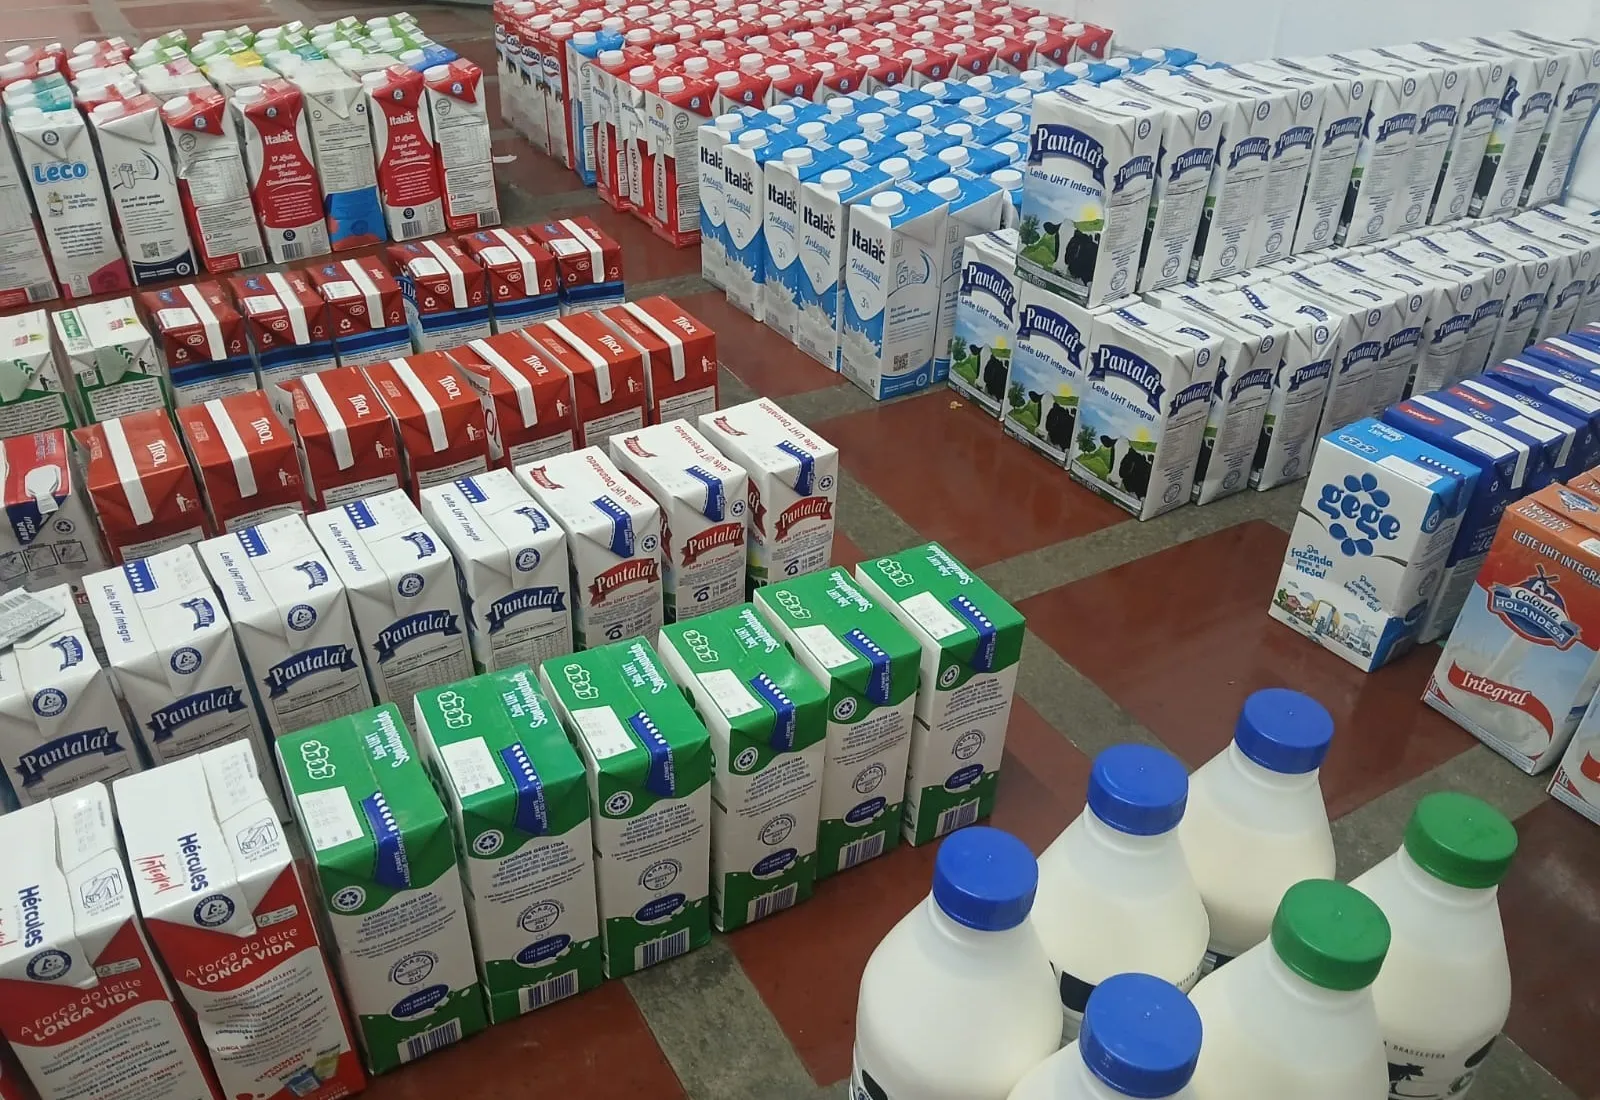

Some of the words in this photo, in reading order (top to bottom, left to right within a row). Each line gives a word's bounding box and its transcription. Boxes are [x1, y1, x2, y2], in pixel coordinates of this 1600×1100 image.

[389, 110, 415, 126] Italac
[265, 130, 295, 145] Italac
[1038, 127, 1103, 168] Pantalat
[1234, 139, 1269, 159] Pantalat
[1279, 129, 1314, 149] Pantalat
[32, 162, 88, 184] Leco
[700, 145, 723, 171] Itala
[724, 164, 754, 196] Italac
[1030, 169, 1048, 181] Leite
[1050, 173, 1069, 187] UHT
[726, 193, 752, 216] Integral
[767, 182, 797, 215] Italac
[768, 211, 796, 236] Integral
[803, 205, 836, 240] Italac
[804, 235, 832, 259] Integral
[852, 226, 887, 265] Italac
[851, 258, 882, 285] Integral
[969, 265, 1014, 304] Pantalat
[273, 320, 287, 330] SIG
[351, 306, 364, 315] SIG
[672, 315, 699, 336] TIROL
[961, 298, 976, 310] Leite
[976, 304, 990, 318] UHT
[988, 310, 1010, 330] Integral
[188, 335, 204, 345] SIG
[1026, 308, 1079, 351] Pantalat
[597, 334, 625, 357] TIROL
[1018, 341, 1035, 355] Leite
[1035, 349, 1050, 364] UHT
[1050, 357, 1076, 378] Integral
[522, 353, 549, 377] TIROL
[1100, 348, 1161, 395] Pantalat
[438, 375, 462, 400] TIROL
[1091, 382, 1110, 397] Leite
[1110, 393, 1126, 407] UHT
[1126, 400, 1155, 422] Integral
[348, 393, 371, 418] TIROL
[758, 401, 792, 428] Desnatado
[250, 416, 274, 445] TIROL
[673, 424, 704, 454] Desnatado
[147, 439, 168, 467] TIROL
[27, 516, 38, 535] AQUI
[450, 505, 467, 521] UHT
[781, 498, 829, 529] Pantalat
[1317, 483, 1401, 541] gege
[16, 521, 30, 543] ABRA
[335, 538, 352, 555] UHT
[688, 523, 742, 555] Pantalat
[1291, 547, 1333, 568] fazenda
[1296, 563, 1327, 580] mesa!
[1512, 529, 1539, 551] LEITE
[1538, 542, 1561, 563] UHT
[1560, 554, 1600, 588] INTEGRA
[227, 567, 243, 584] UHT
[595, 559, 656, 593] Pantalat
[109, 602, 124, 617] UHT
[492, 586, 559, 621] Pantalat
[1514, 588, 1560, 621] Colônia
[380, 611, 452, 648] Pantalat
[1494, 598, 1566, 643] HOLANDESA
[269, 647, 348, 686] Pantalat
[1460, 671, 1530, 707] Integral
[153, 687, 235, 730] Pantalat
[23, 731, 110, 774] Pantalat
[133, 853, 185, 895] Integral
[177, 832, 209, 893] Hércules
[18, 884, 44, 949] Hércules
[185, 968, 196, 979] A
[199, 952, 237, 974] força
[241, 942, 260, 955] do
[263, 928, 298, 946] leite
[196, 957, 253, 986] LONGA
[254, 940, 296, 961] VIDA
[20, 1026, 32, 1037] A
[34, 1002, 77, 1029] força
[81, 990, 101, 1005] do
[106, 978, 142, 996] leite
[33, 1006, 95, 1042] LONGA
[95, 990, 140, 1009] VIDA
